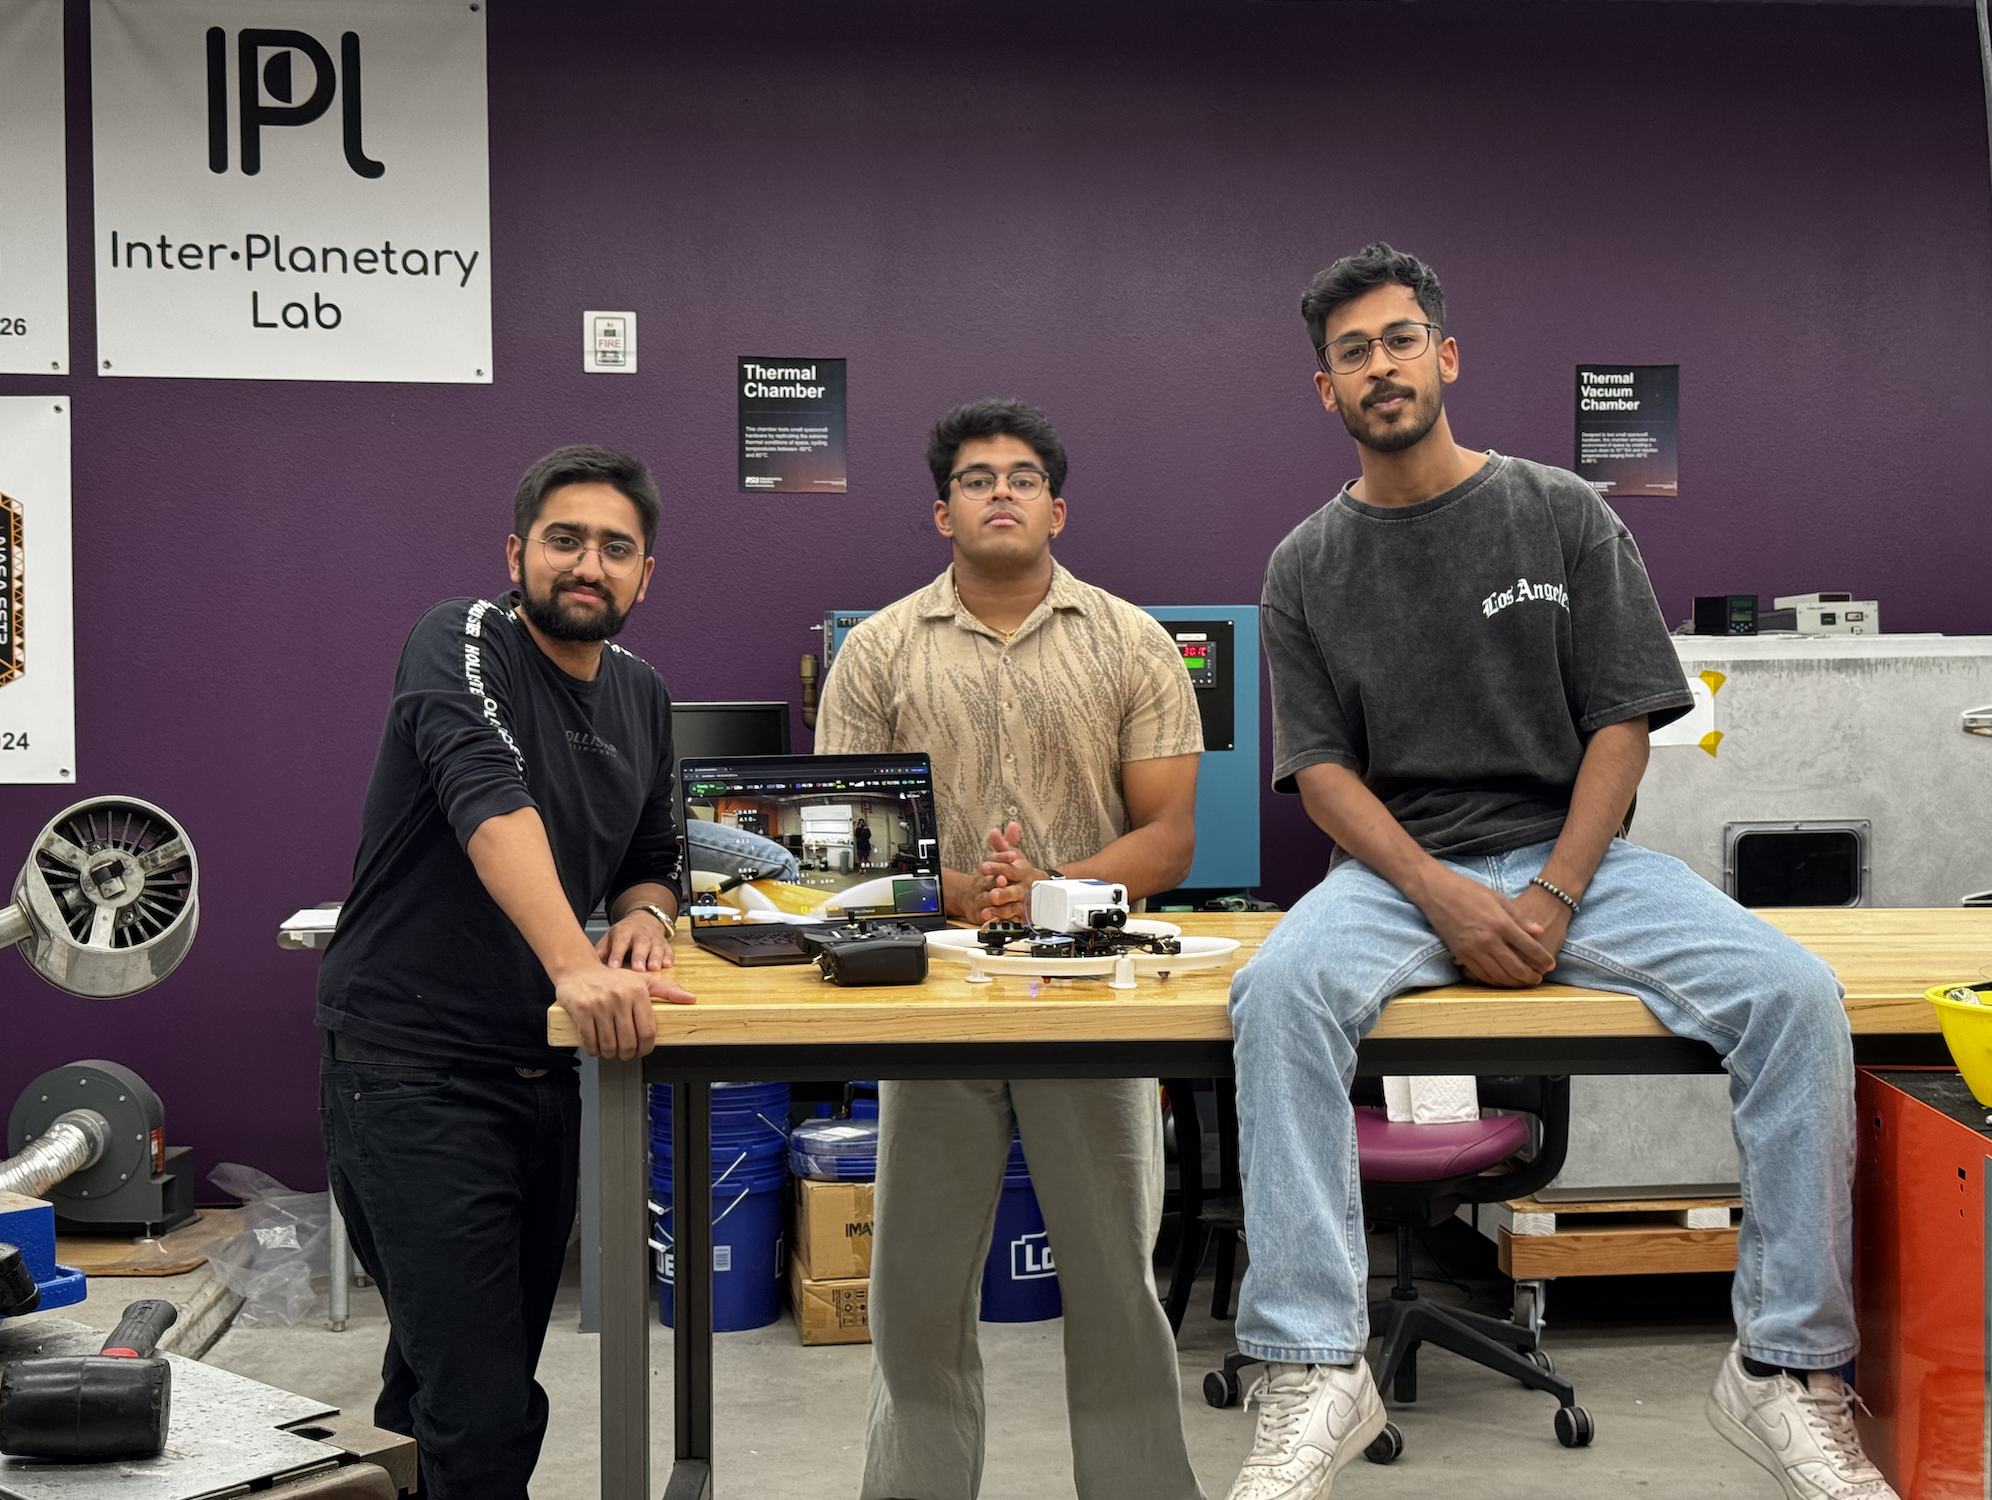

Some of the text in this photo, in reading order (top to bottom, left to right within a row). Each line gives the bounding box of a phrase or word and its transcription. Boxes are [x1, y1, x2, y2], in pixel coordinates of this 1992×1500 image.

[252, 291, 342, 330] Lab
[598, 339, 622, 348] FIRE
[743, 364, 817, 381] Thermal
[1581, 371, 1634, 385] Thermal
[743, 382, 825, 399] Chamber
[1581, 385, 1633, 398] Vacuum
[1581, 398, 1641, 411] Chamber
[1481, 585, 1515, 619] Los
[0, 732, 30, 751] 24
[845, 1221, 874, 1238] IMA
